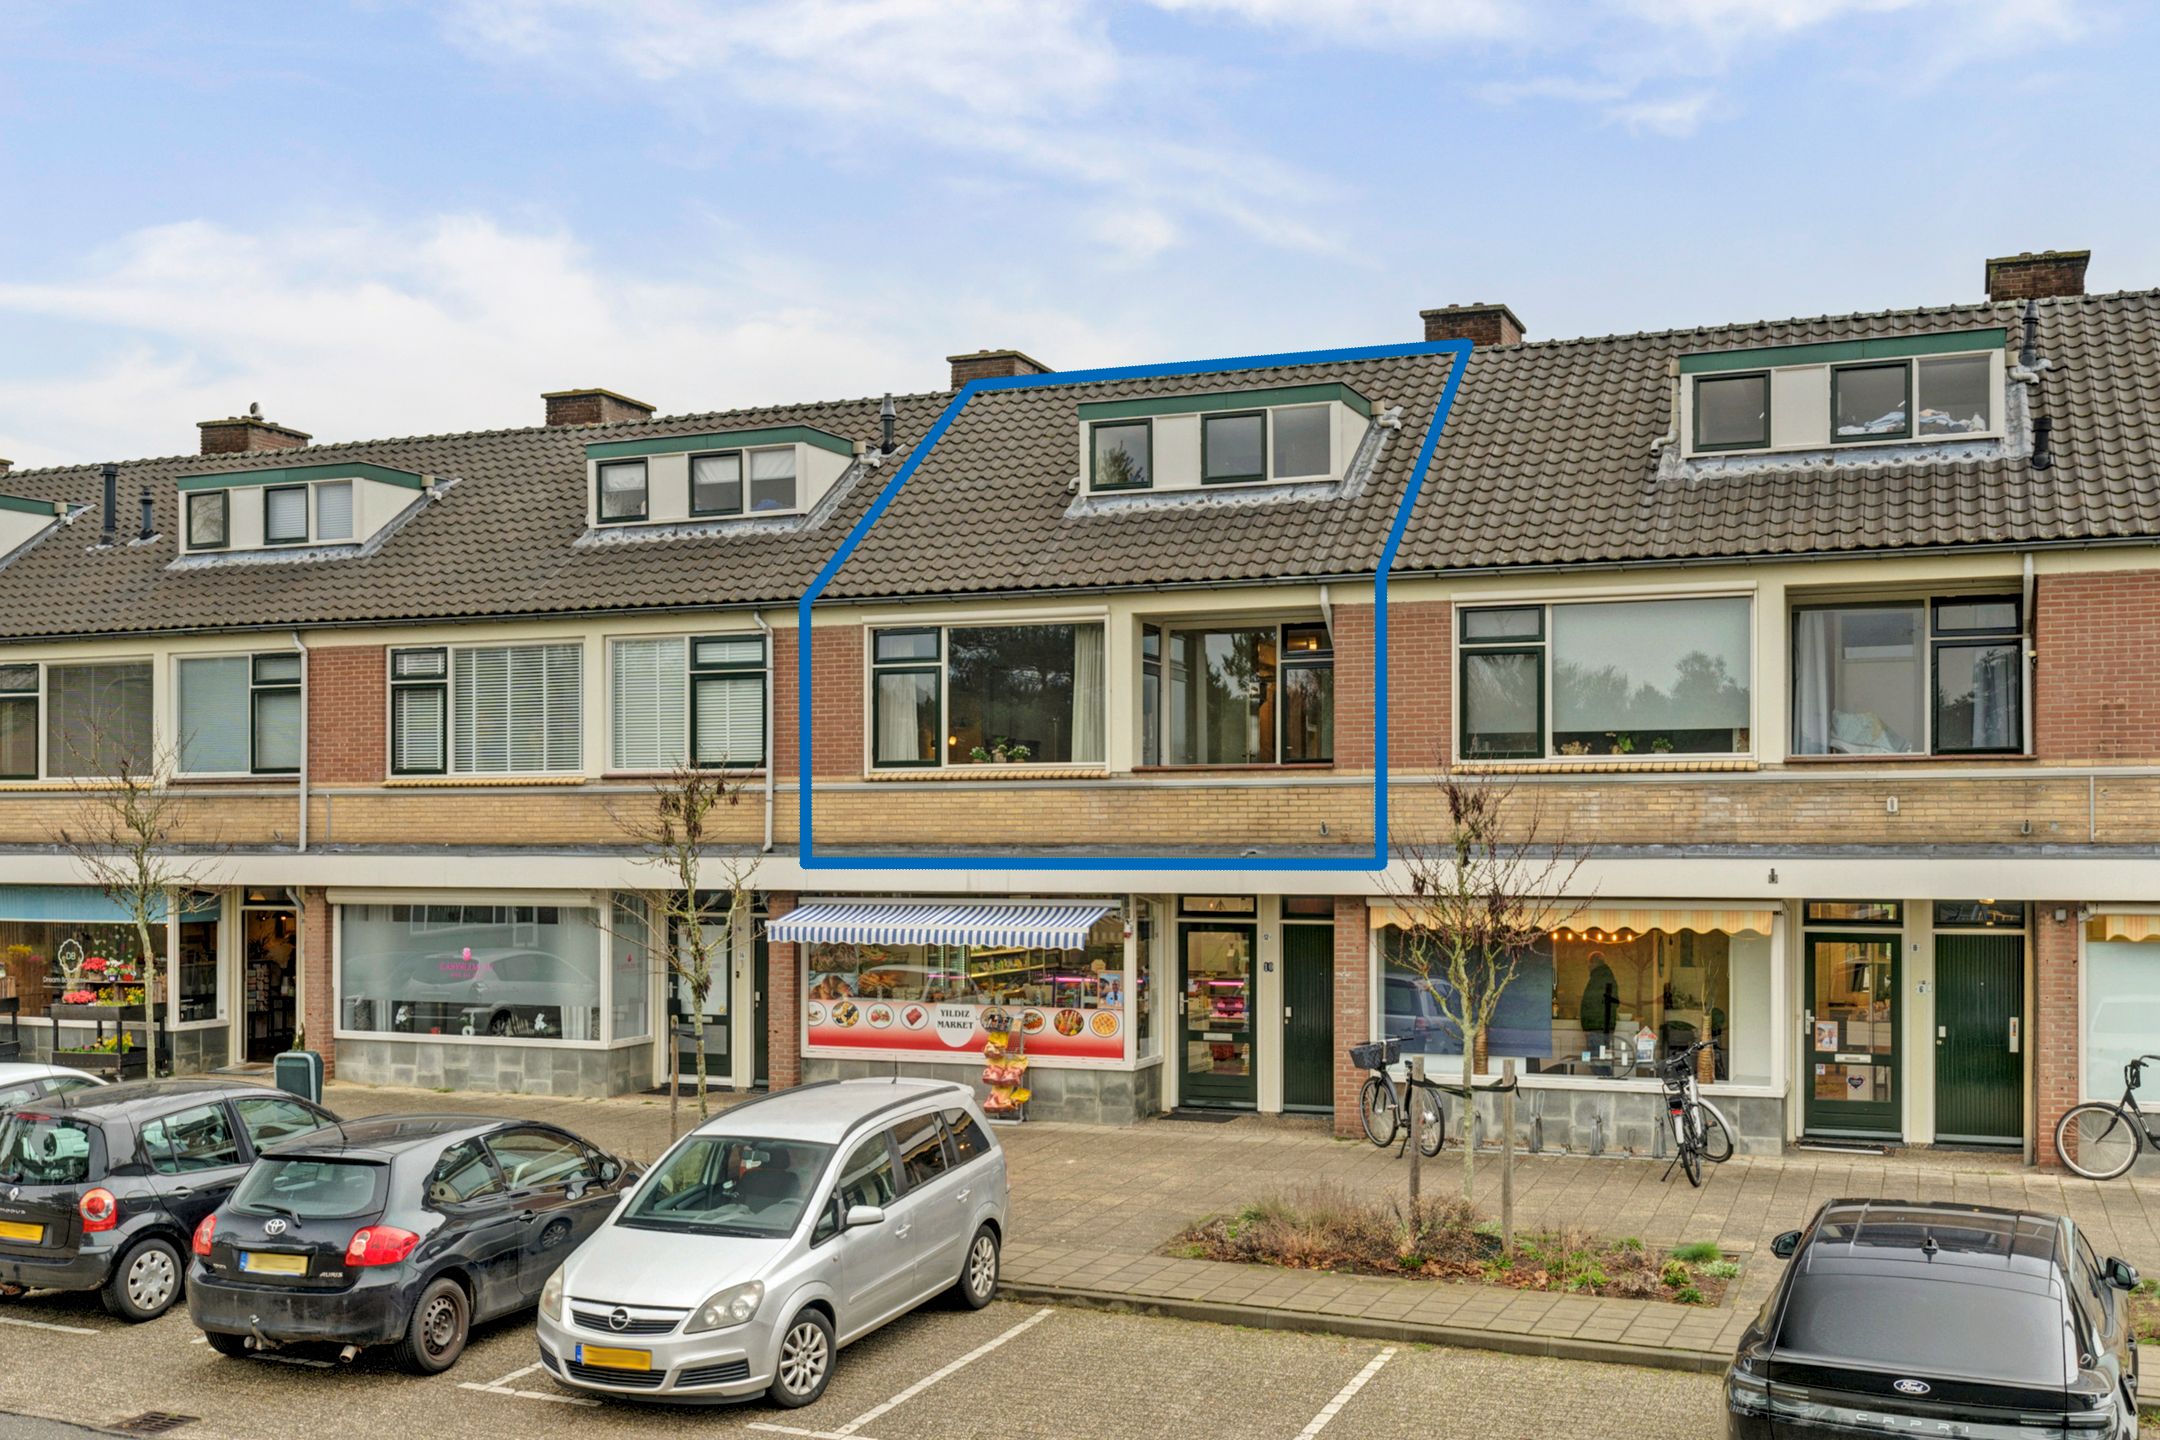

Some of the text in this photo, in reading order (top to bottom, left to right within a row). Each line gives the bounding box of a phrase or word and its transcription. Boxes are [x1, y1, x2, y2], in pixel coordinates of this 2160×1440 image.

[940, 1009, 970, 1018] YILDIZ
[937, 1021, 973, 1029] MARKET
[319, 1271, 344, 1279] AURIS
[1855, 1412, 1970, 1433] CAPRI
